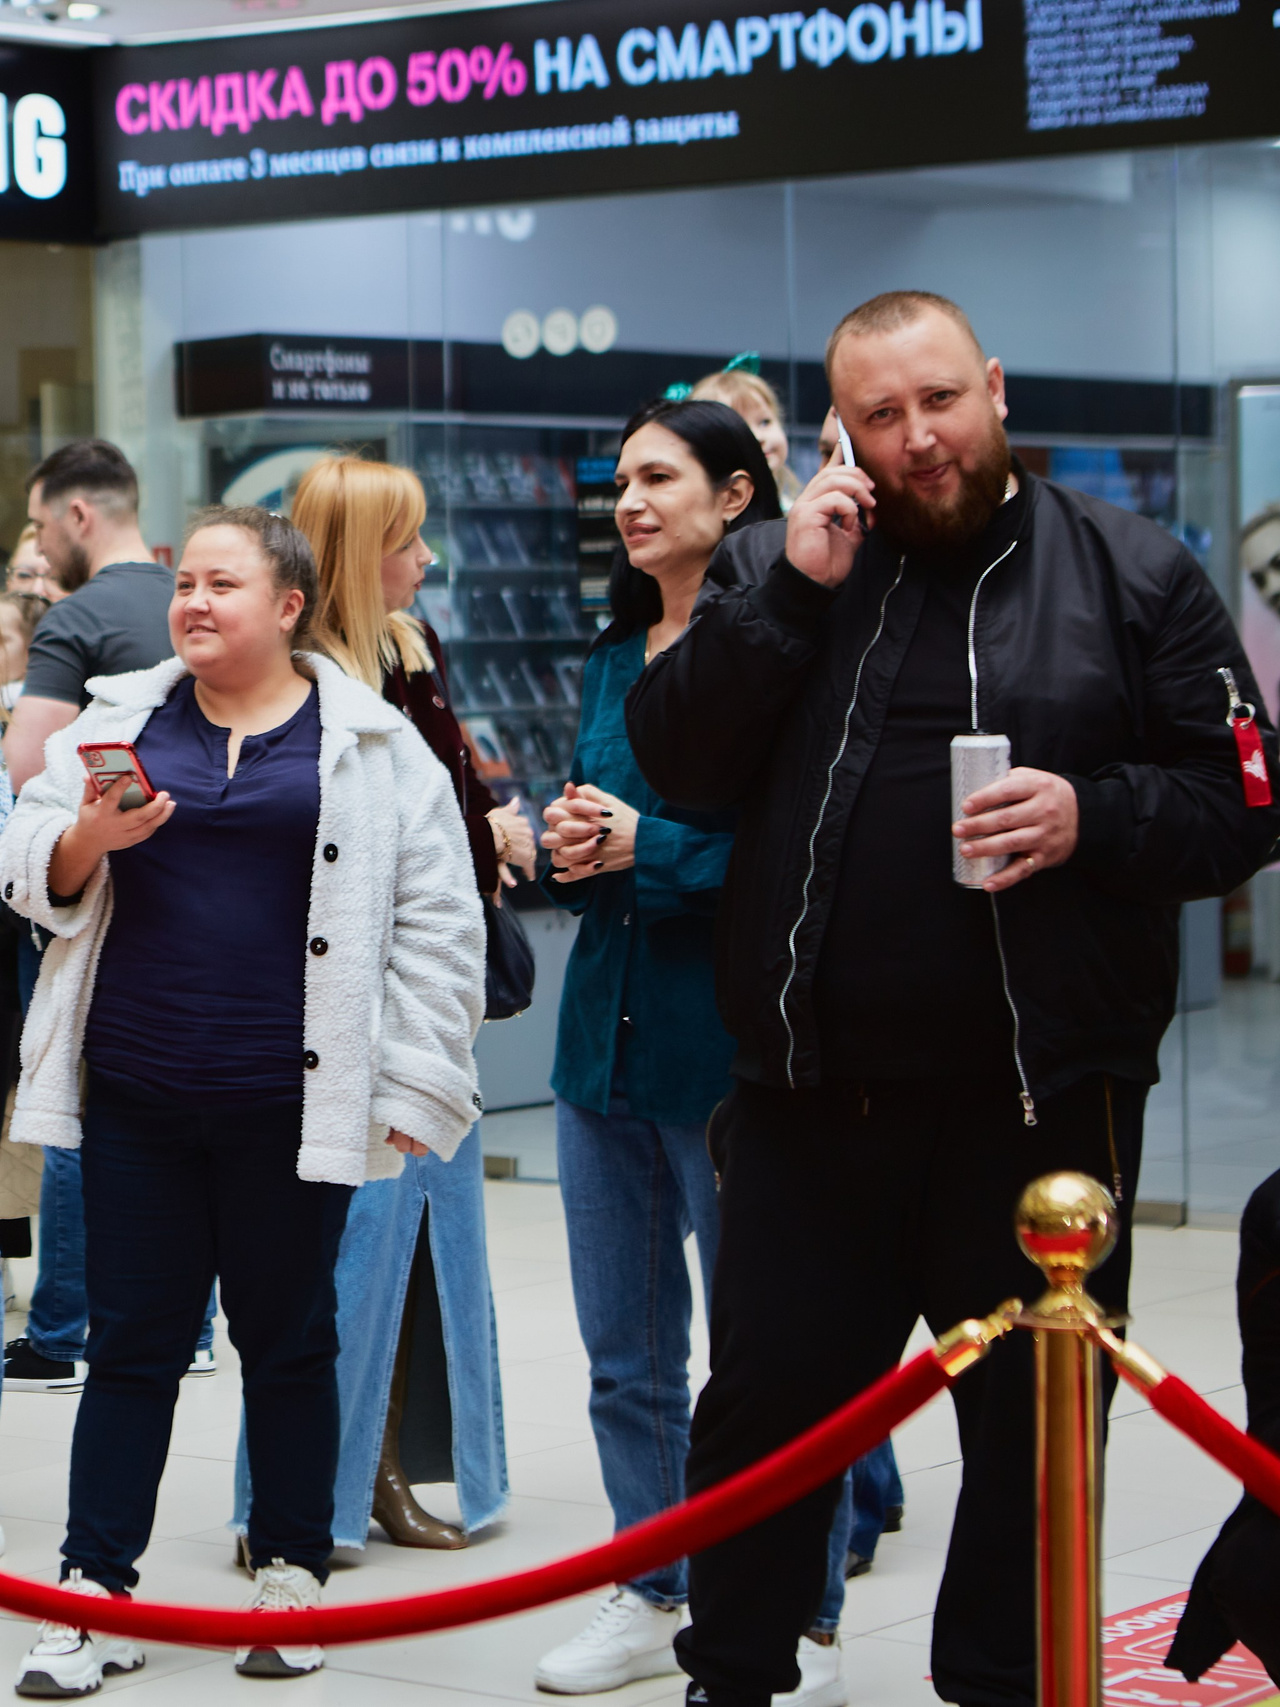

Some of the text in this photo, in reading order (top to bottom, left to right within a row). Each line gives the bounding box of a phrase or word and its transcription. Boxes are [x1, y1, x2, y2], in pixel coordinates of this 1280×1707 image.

[115, 65, 314, 136] СКИДКА
[321, 55, 397, 126] ДО
[406, 42, 528, 107] 50%
[534, 34, 610, 95] НА
[617, 0, 984, 86] СМАРТФОНЫ
[119, 110, 740, 197] При оплате 3 месяцев связи и комплексной защиты
[270, 343, 371, 379] Смартфоны
